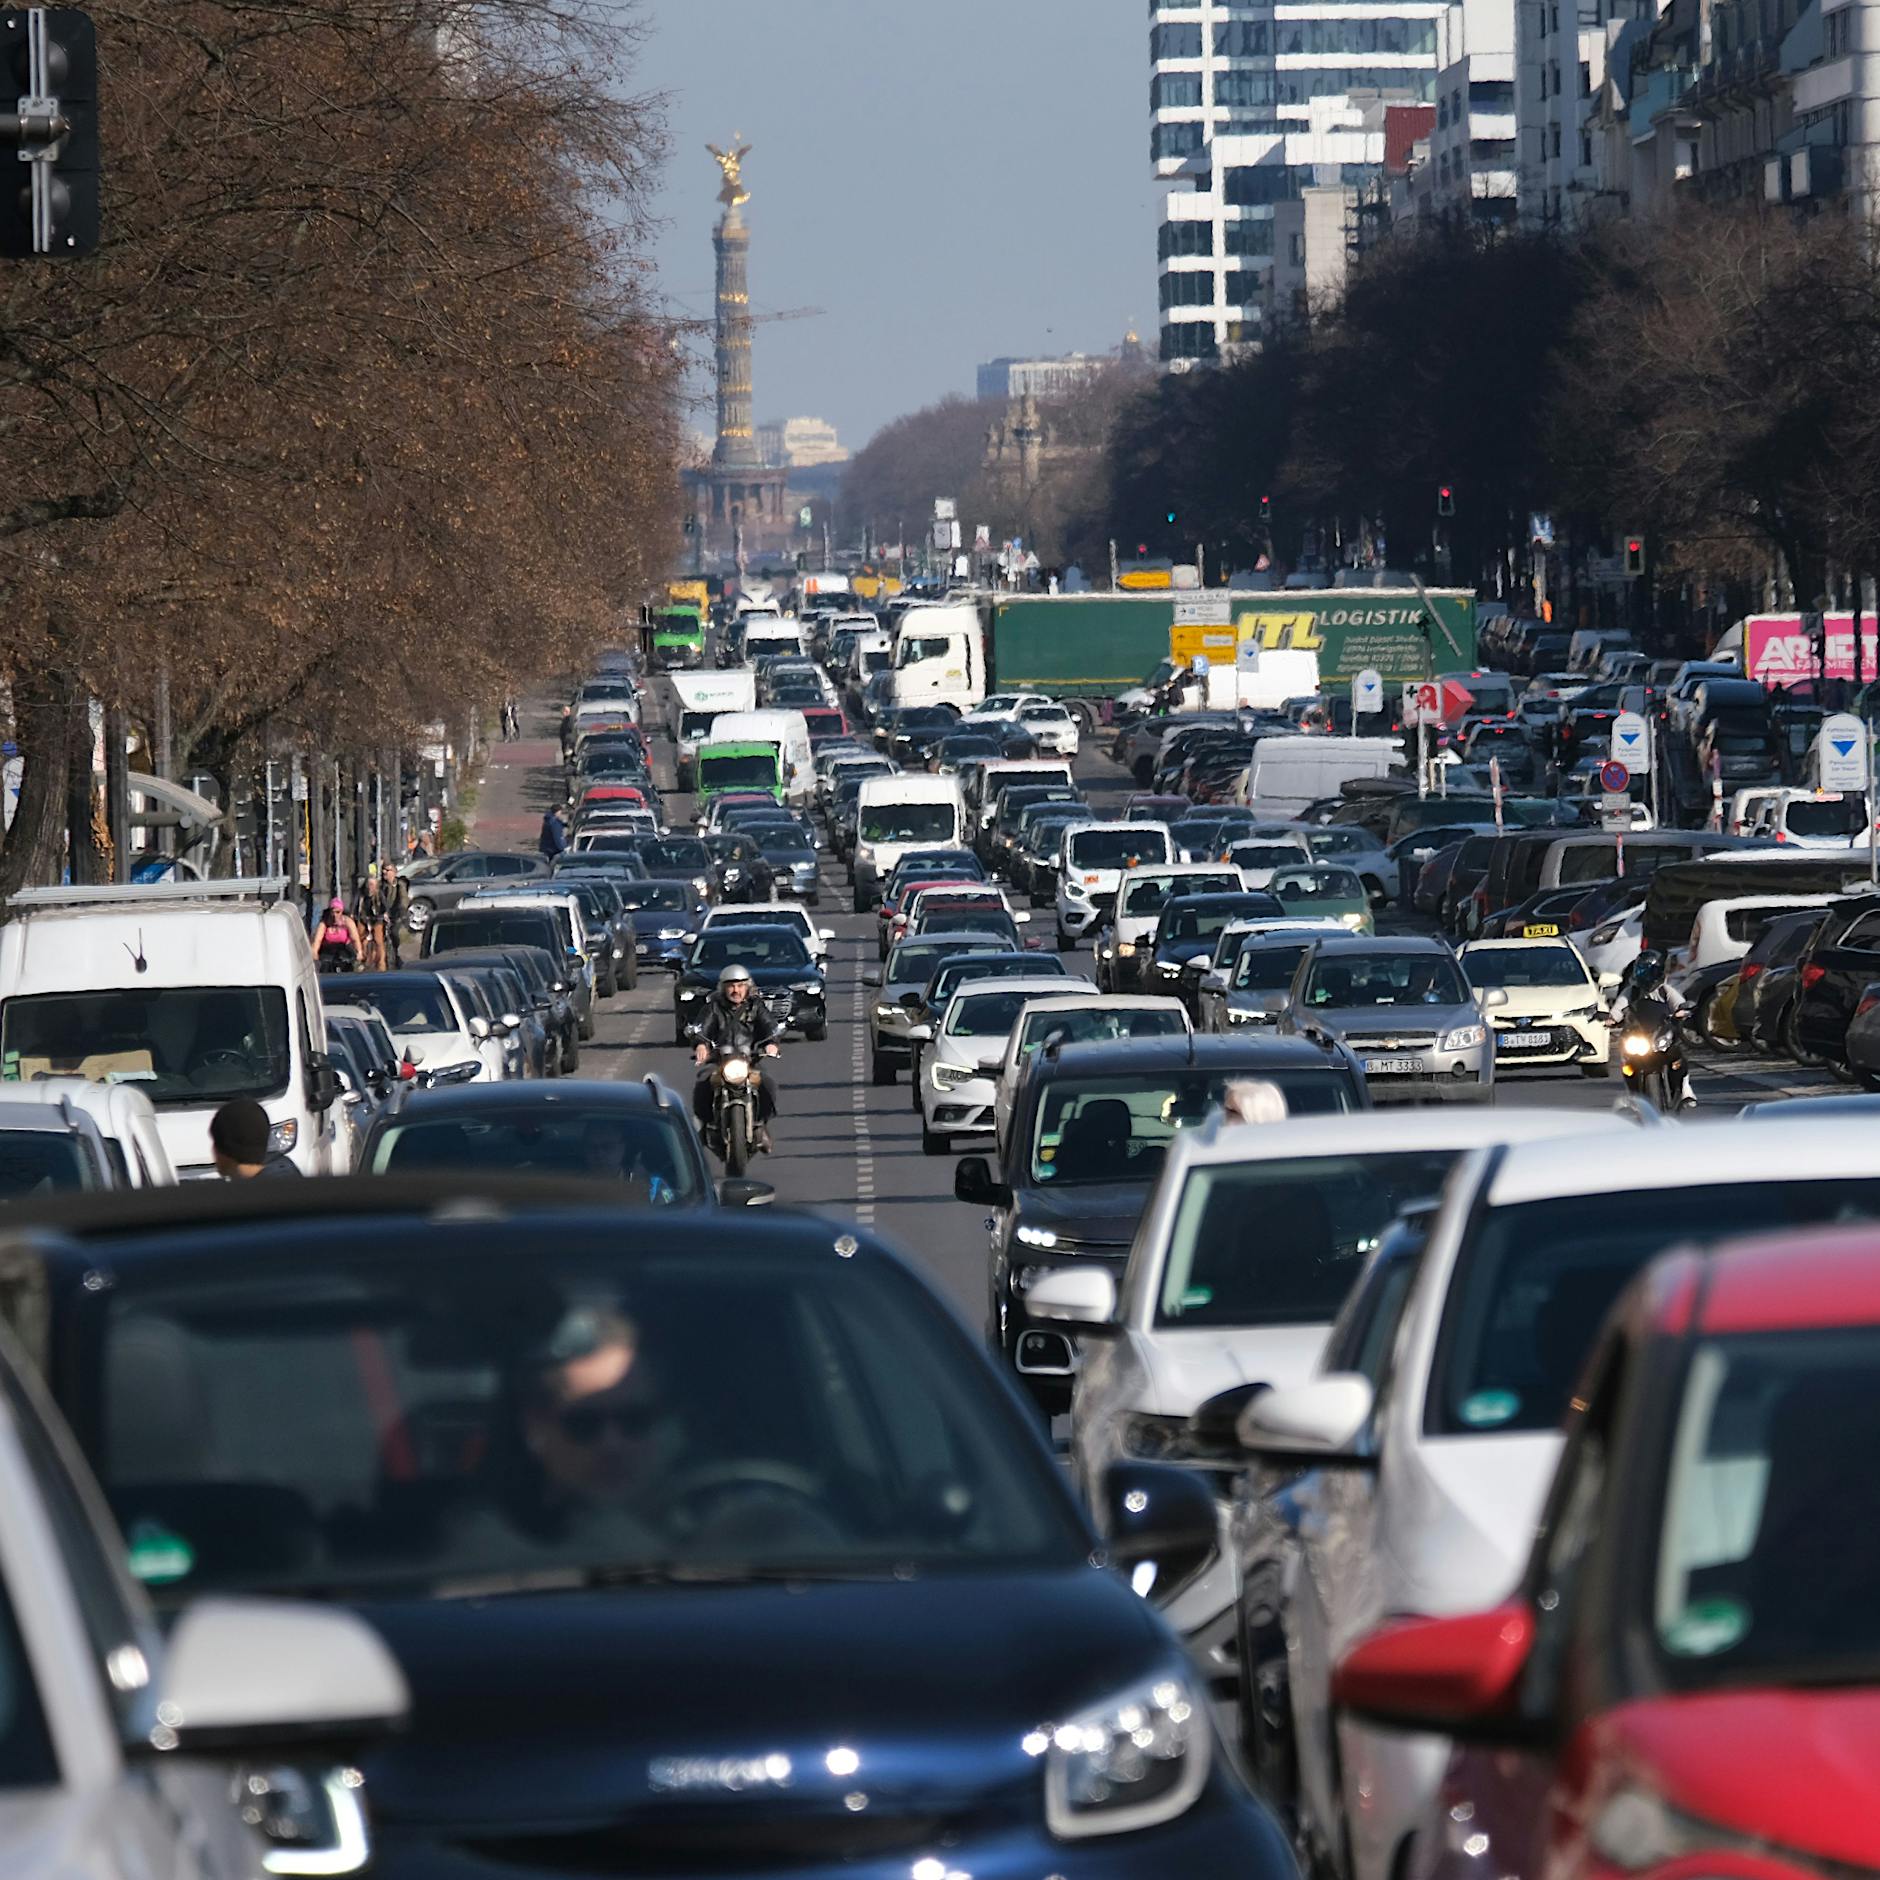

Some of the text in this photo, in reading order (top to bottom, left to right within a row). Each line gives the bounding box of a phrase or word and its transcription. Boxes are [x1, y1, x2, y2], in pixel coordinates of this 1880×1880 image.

[1238, 611, 1325, 652] ITL
[1319, 608, 1423, 626] LOGISTIK
[1528, 926, 1553, 936] TAXI
[1380, 1061, 1393, 1072] MT
[1396, 1061, 1422, 1072] 3333
